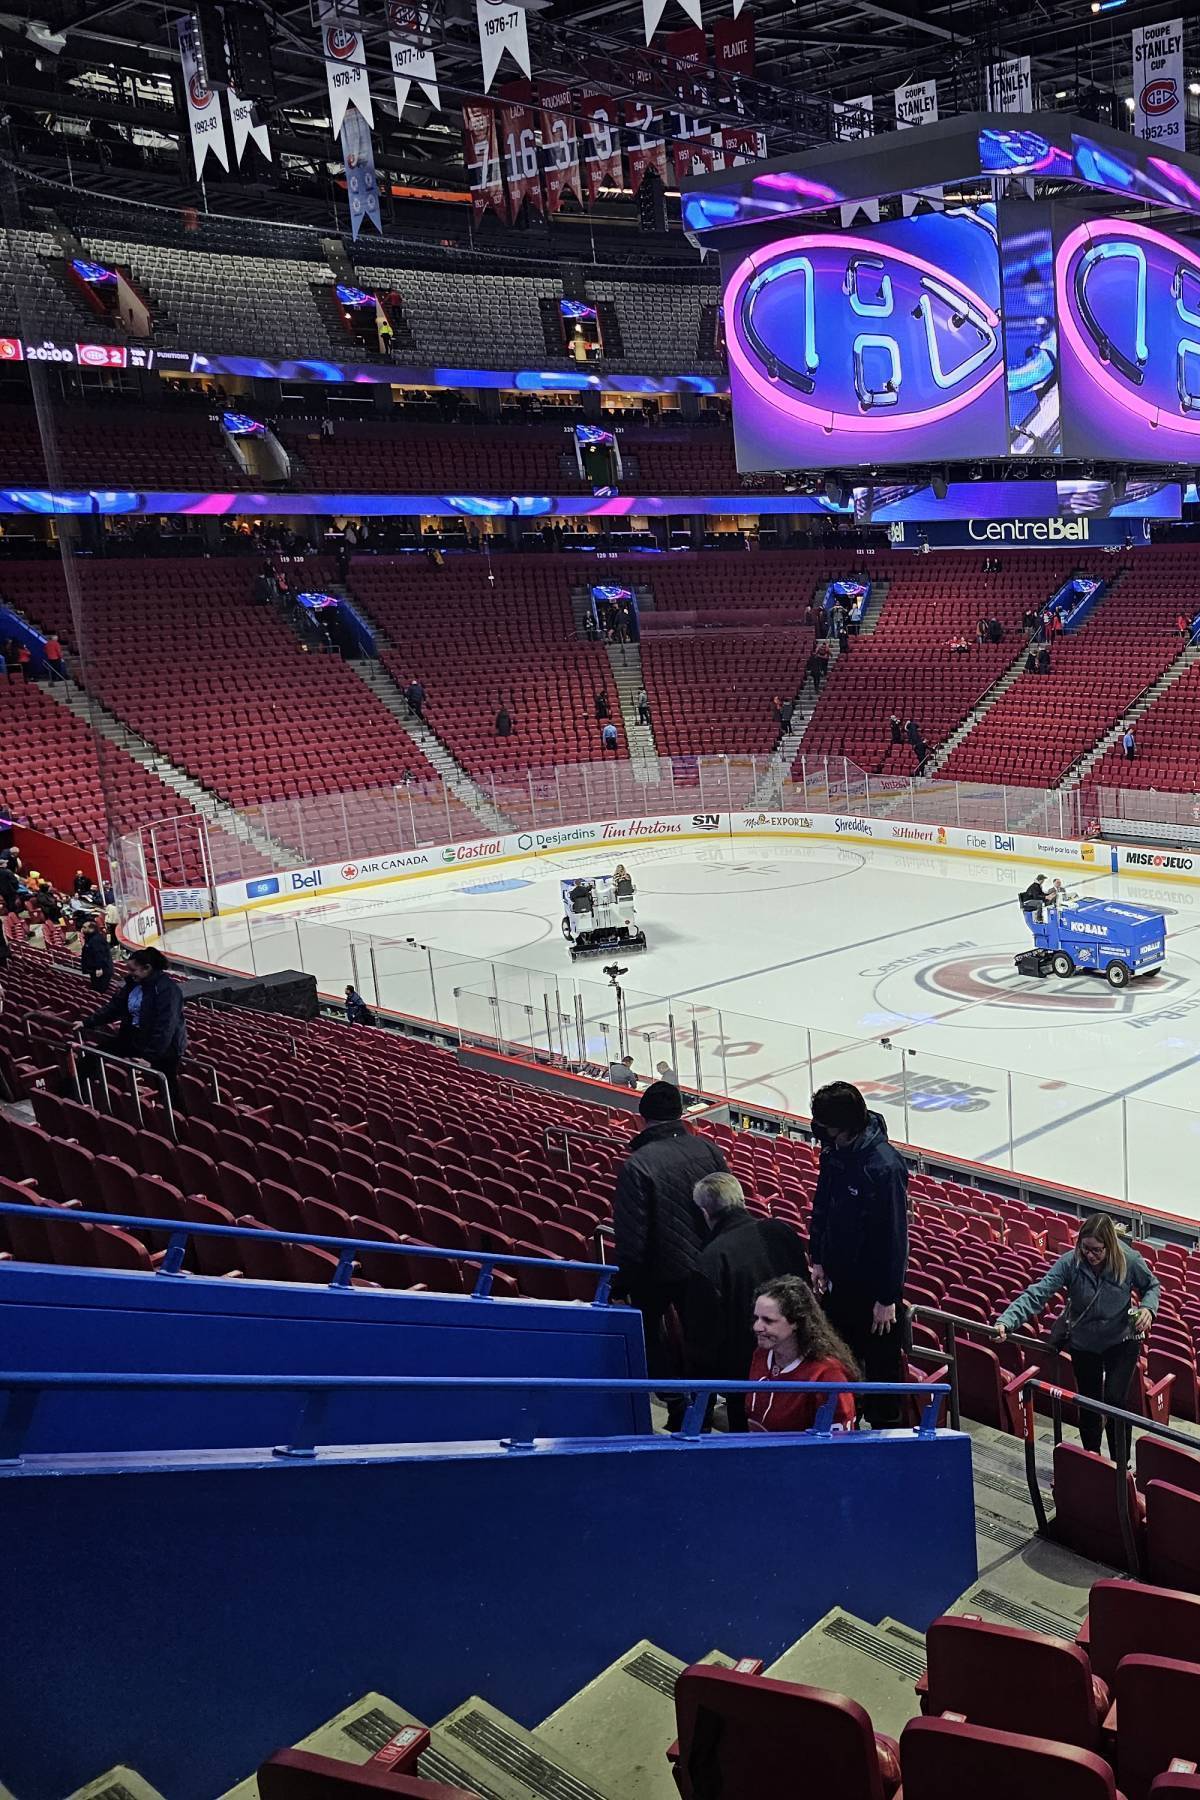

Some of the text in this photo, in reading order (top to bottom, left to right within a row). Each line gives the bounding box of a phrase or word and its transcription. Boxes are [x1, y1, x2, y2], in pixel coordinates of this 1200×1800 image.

[485, 12, 518, 36] 1976-77
[1145, 26, 1171, 41] COUPE
[723, 40, 748, 59] PLANTE
[1135, 35, 1181, 62] STANLEY
[996, 63, 1019, 78] COUPE
[1151, 59, 1166, 71] CUP
[332, 68, 361, 88] 1978-79
[989, 72, 1030, 97] STANLEY
[905, 86, 926, 99] COUPE
[1003, 94, 1017, 106] CUP
[510, 106, 525, 119] LACH
[897, 95, 935, 118] STANLEY
[194, 117, 218, 134] 1992-93
[593, 109, 613, 160] 9
[1141, 122, 1179, 141] 1952-53
[552, 119, 570, 170] 3
[506, 128, 538, 182] 16
[474, 140, 489, 190] 7
[26, 347, 74, 362] 20:00
[110, 350, 122, 364] 2
[968, 517, 1089, 540] CentreBell
[601, 820, 681, 839] Tim Hortons
[692, 815, 720, 826] SN
[835, 817, 872, 836] Shreddies
[536, 829, 596, 846] Desjardins
[966, 835, 1015, 852] Fibe Bell
[457, 841, 500, 860] Castrol
[361, 855, 429, 874] AIR CANADA
[292, 870, 322, 890] Bell
[1071, 921, 1108, 936] KOBALT
[1140, 941, 1161, 955] KOBALT
